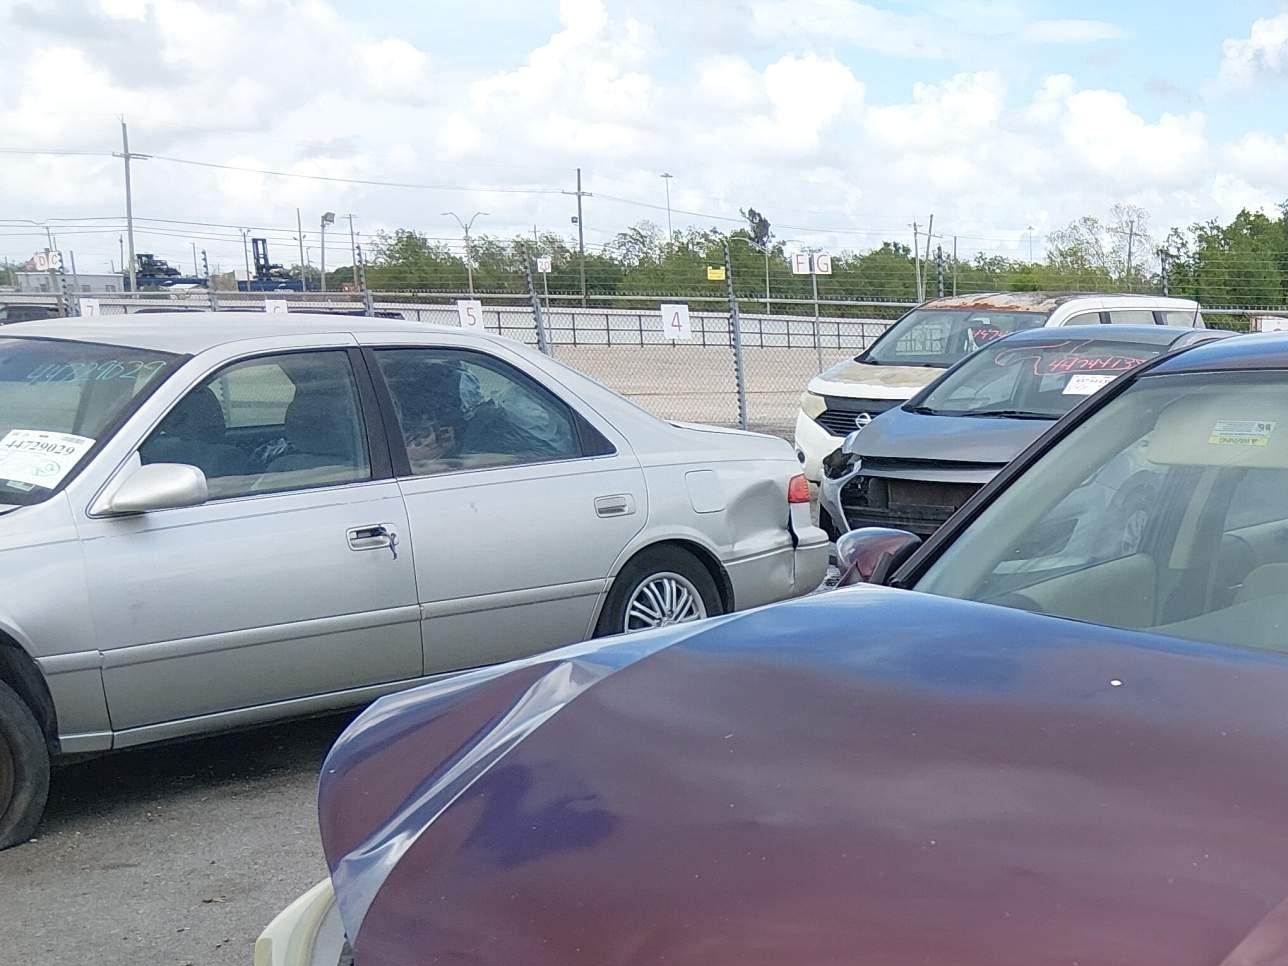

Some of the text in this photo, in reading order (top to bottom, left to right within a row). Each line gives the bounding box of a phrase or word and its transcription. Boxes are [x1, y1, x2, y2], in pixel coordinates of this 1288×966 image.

[796, 254, 806, 269] F
[816, 254, 829, 273] G
[466, 307, 476, 326] 5
[671, 311, 683, 331] 4
[5, 439, 76, 456] 44729029
